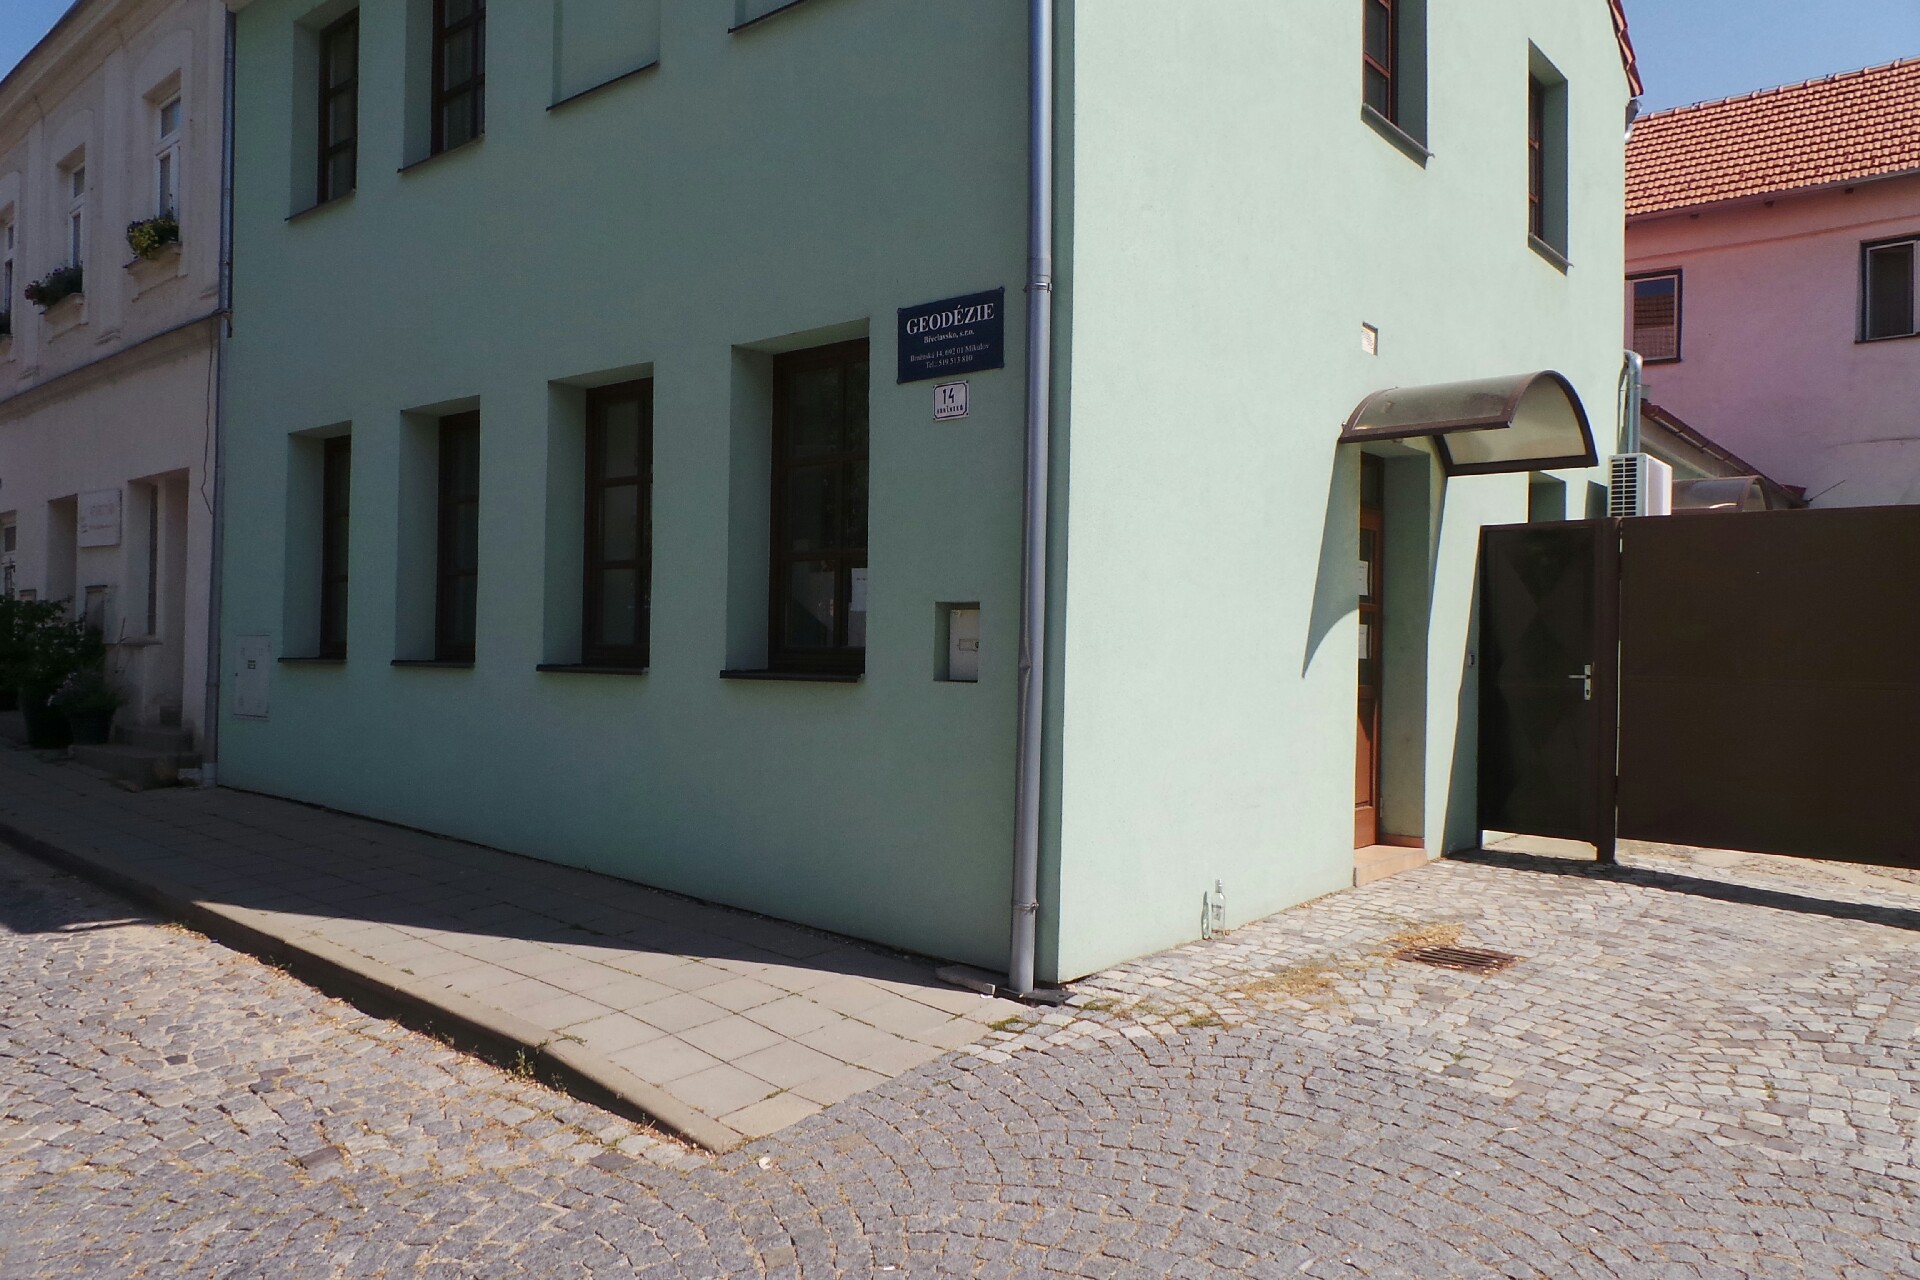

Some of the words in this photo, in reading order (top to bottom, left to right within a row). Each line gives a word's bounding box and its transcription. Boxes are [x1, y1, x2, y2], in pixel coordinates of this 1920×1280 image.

[906, 303, 995, 335] GEODÉZIE
[959, 329, 975, 337] s.r.o.
[965, 343, 990, 353] Mikulov
[942, 387, 955, 405] 14
